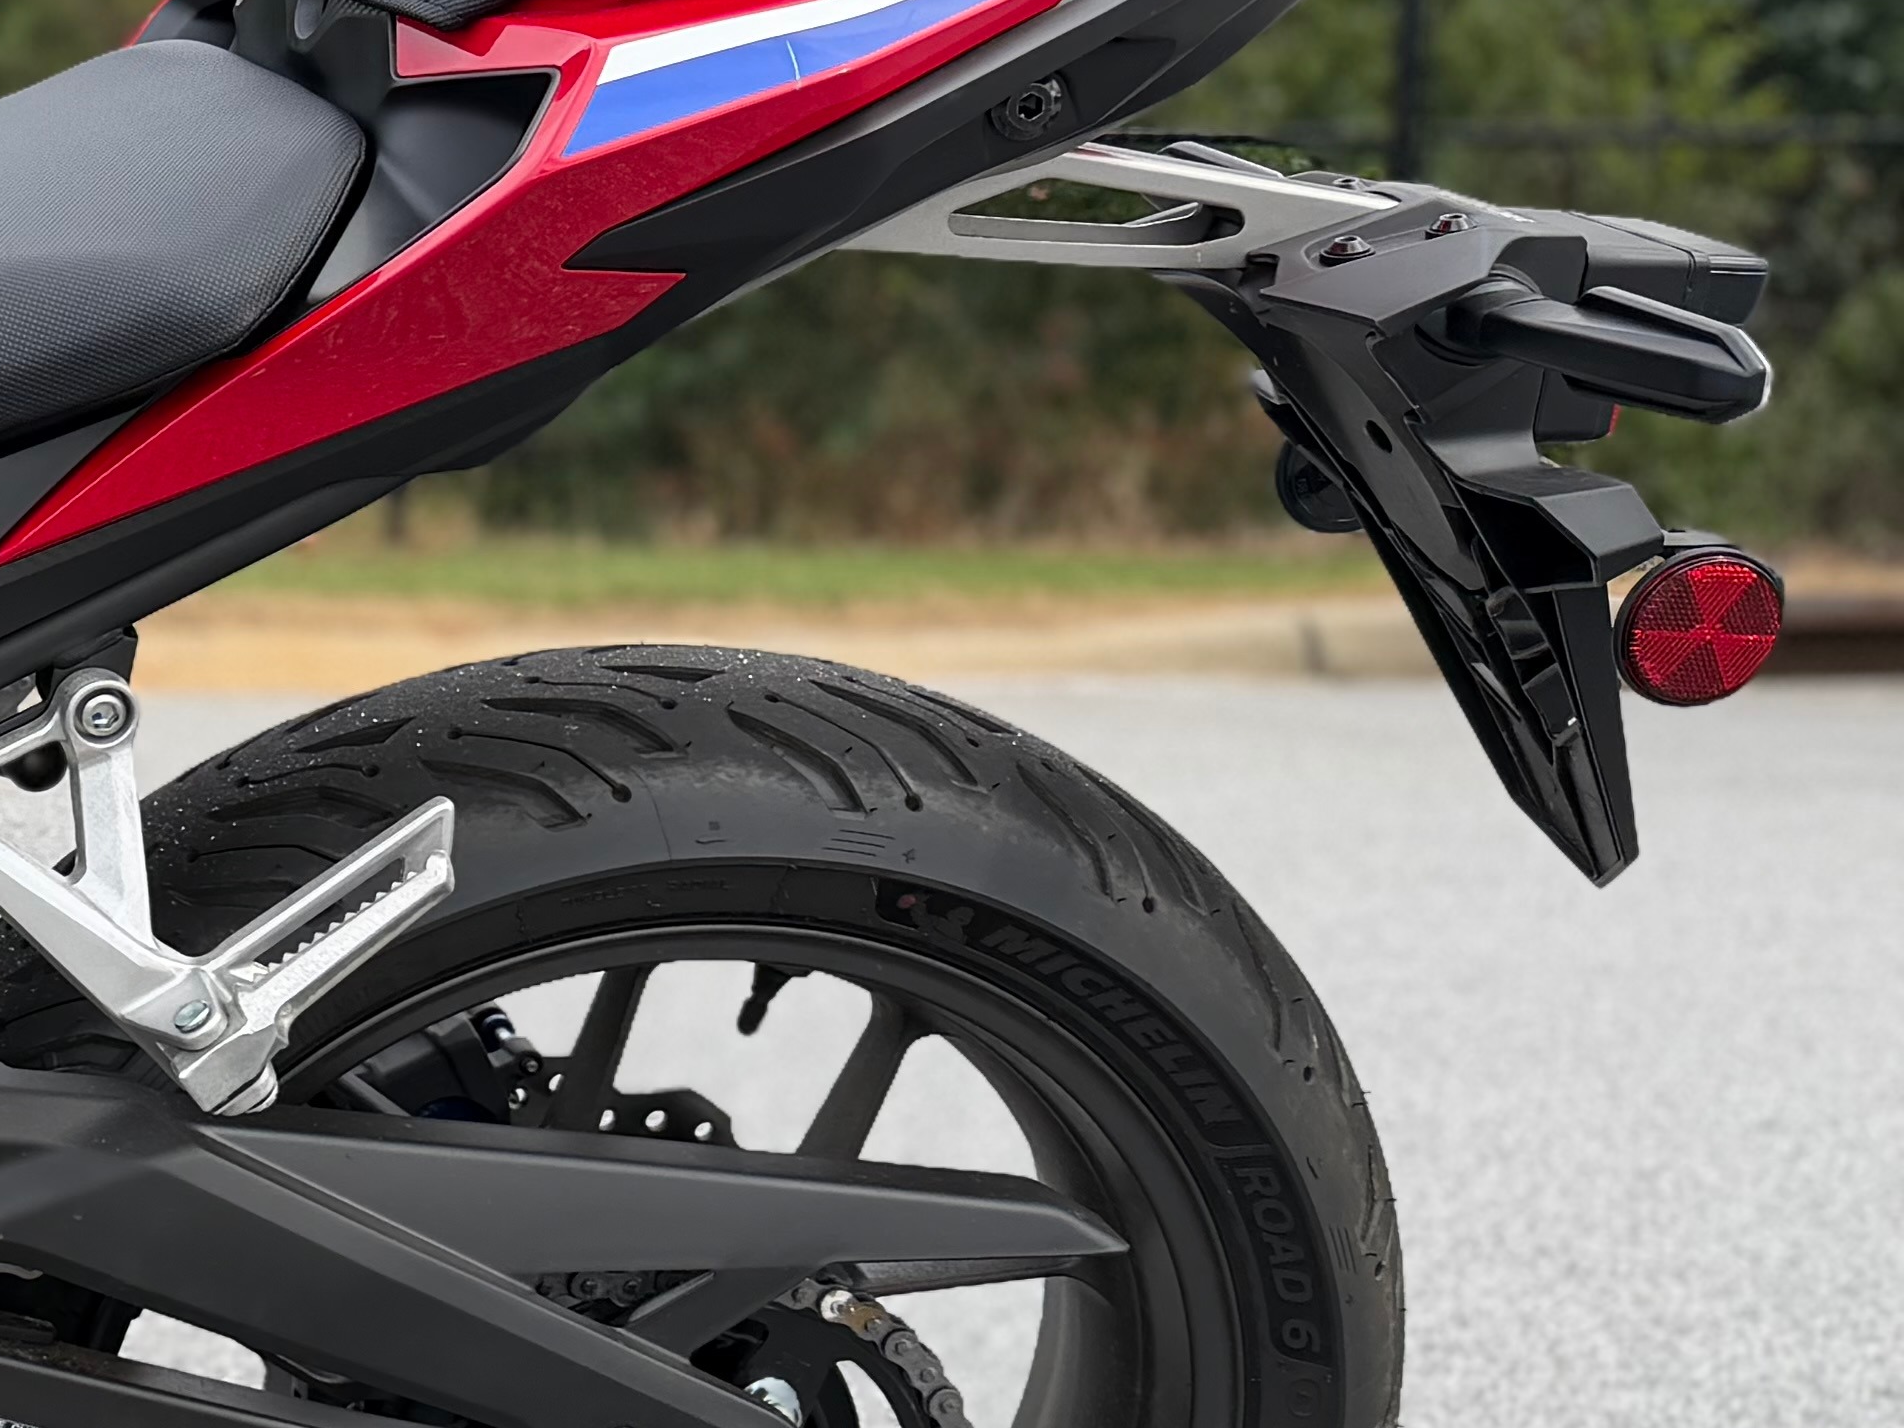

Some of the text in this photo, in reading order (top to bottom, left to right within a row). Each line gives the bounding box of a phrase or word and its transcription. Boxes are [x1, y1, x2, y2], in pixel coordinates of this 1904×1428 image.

[980, 924, 1244, 1140] MICHELIN
[1235, 1164, 1321, 1353] ROAD 6
